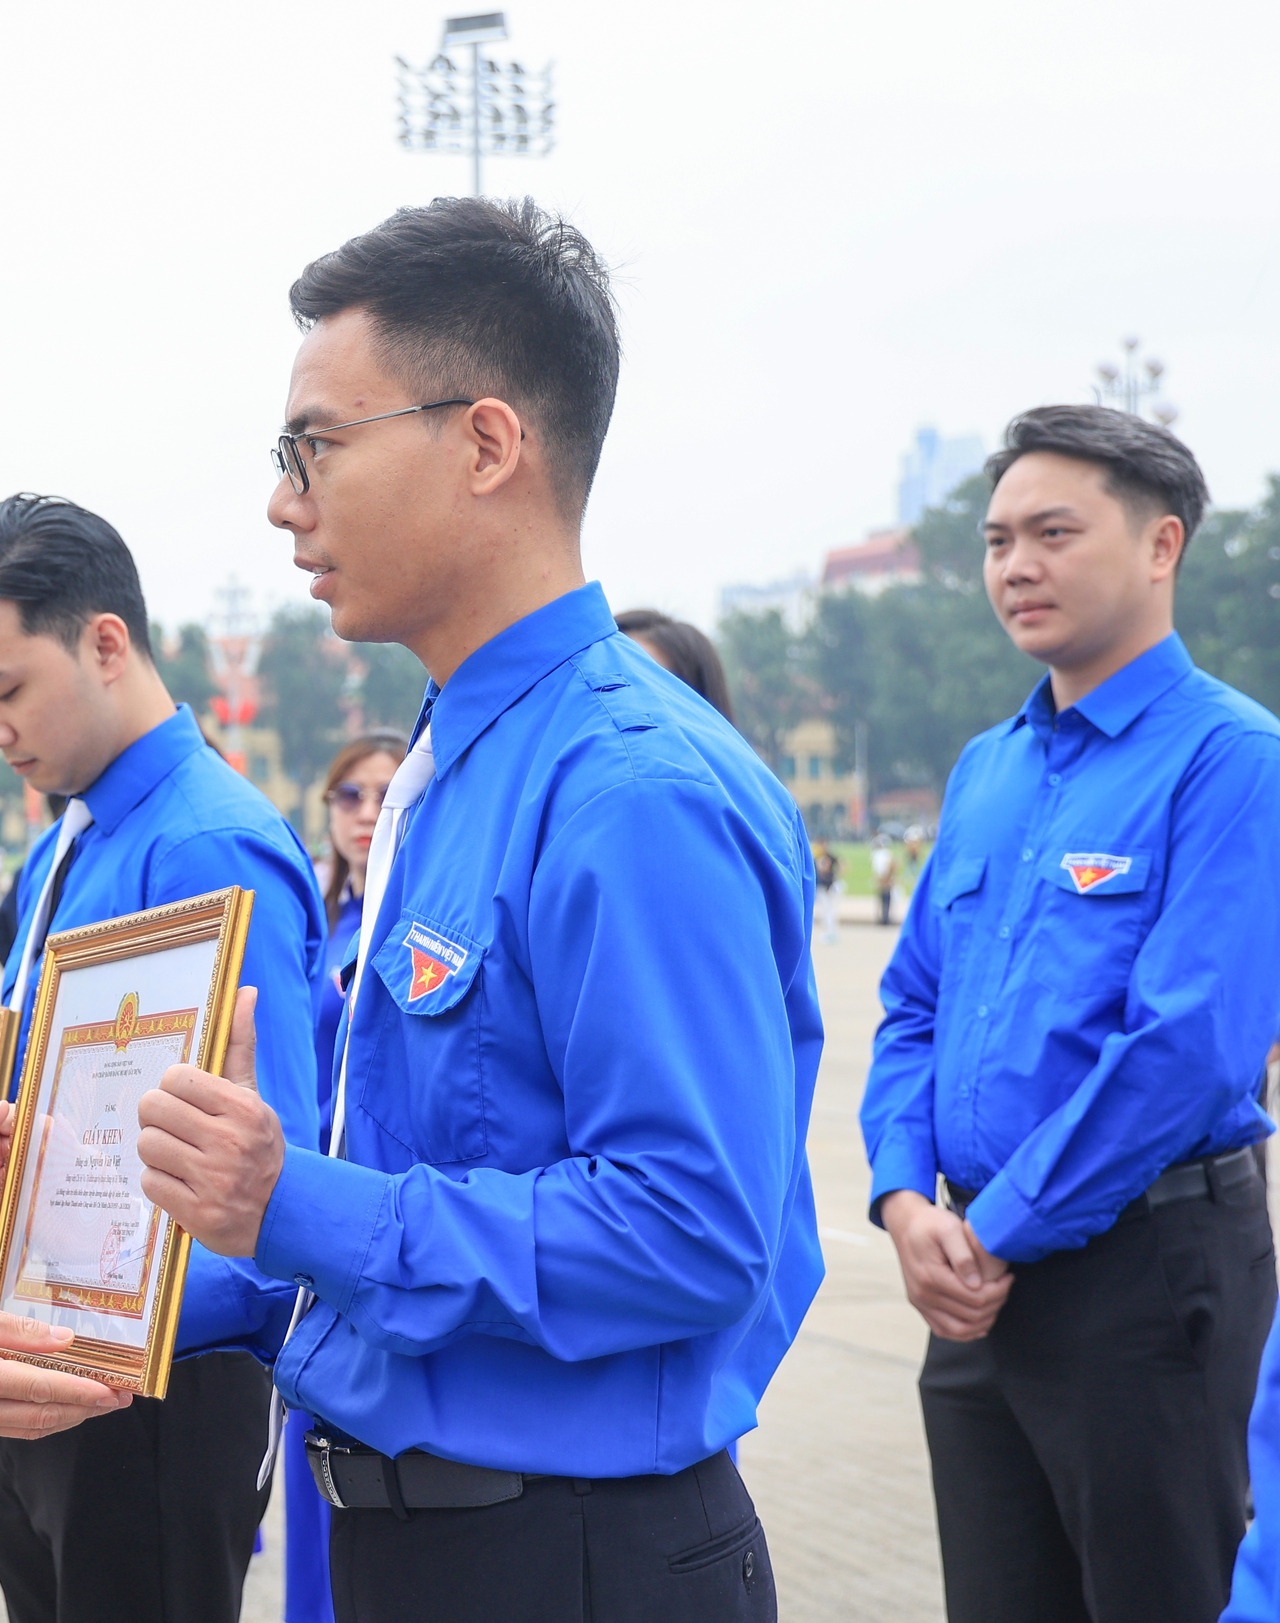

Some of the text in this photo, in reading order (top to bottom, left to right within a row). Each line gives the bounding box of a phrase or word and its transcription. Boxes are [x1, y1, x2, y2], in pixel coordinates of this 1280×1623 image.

[410, 929, 431, 949] THANH
[440, 946, 454, 962] VIỆT
[82, 1122, 124, 1145] GIẤY KHEN
